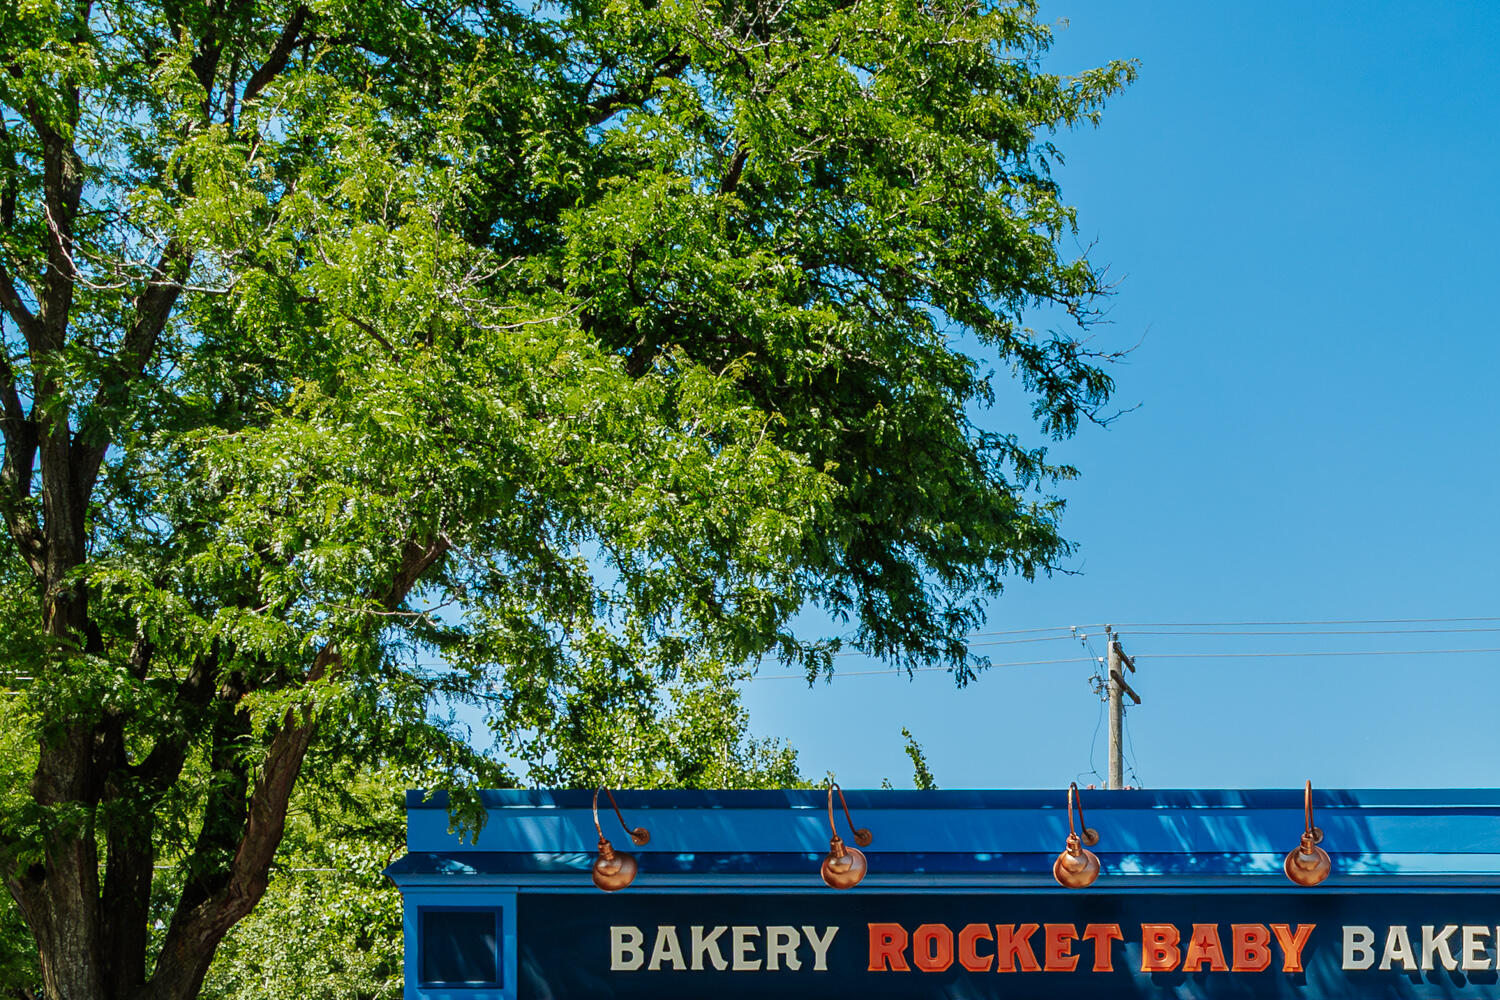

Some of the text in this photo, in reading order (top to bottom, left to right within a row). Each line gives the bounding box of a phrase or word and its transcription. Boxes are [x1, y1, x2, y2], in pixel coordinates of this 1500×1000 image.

[609, 925, 840, 972] BAKERY
[867, 922, 1125, 973] ROCKET
[1140, 923, 1318, 973] BABY
